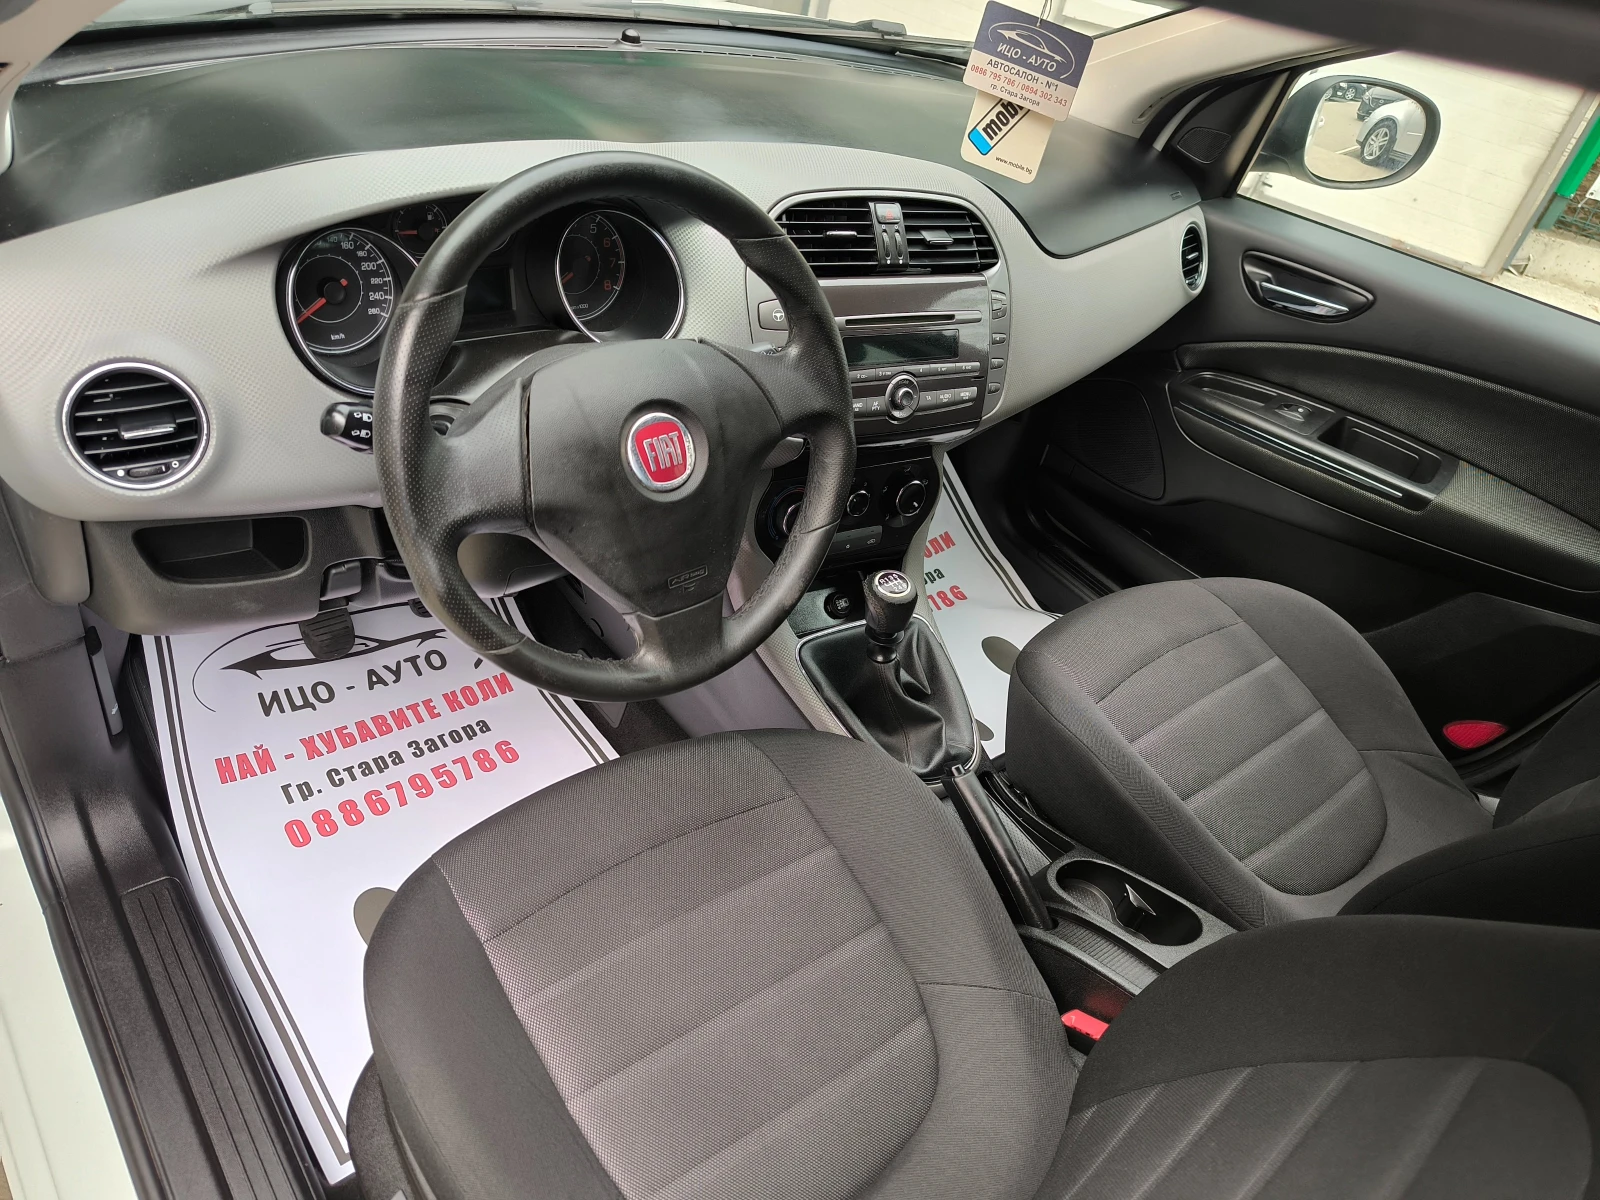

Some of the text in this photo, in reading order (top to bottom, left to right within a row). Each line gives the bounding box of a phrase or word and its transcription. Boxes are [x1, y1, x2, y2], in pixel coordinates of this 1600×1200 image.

[997, 43, 1021, 58] ИЦО
[1027, 55, 1056, 71] АУТО
[987, 59, 1039, 84] АВТОСАЛОН
[971, 65, 987, 76] 0886
[989, 71, 1001, 82] 795
[1003, 77, 1016, 87] 786
[1021, 84, 1038, 96] 0894
[1039, 91, 1052, 101] 302
[1054, 96, 1067, 107] 343
[1000, 86, 1017, 98] Стара
[1019, 93, 1040, 106] Загора
[995, 156, 1032, 175] www.mobile.bg
[590, 223, 597, 233] 5
[341, 241, 354, 249] 160
[604, 238, 610, 247] 6
[361, 262, 376, 270] 200
[369, 292, 384, 300] 240
[604, 280, 612, 290] 8
[643, 431, 683, 472] FIAT
[258, 680, 336, 717] ИЦО
[366, 649, 448, 691] АУТО
[215, 744, 276, 784] НАЙ
[299, 698, 442, 761] ХУБАВИТЕ
[442, 672, 514, 713] КОЛИ
[281, 718, 492, 804] Гр. Стара Загора
[284, 740, 520, 848] 0886795786
